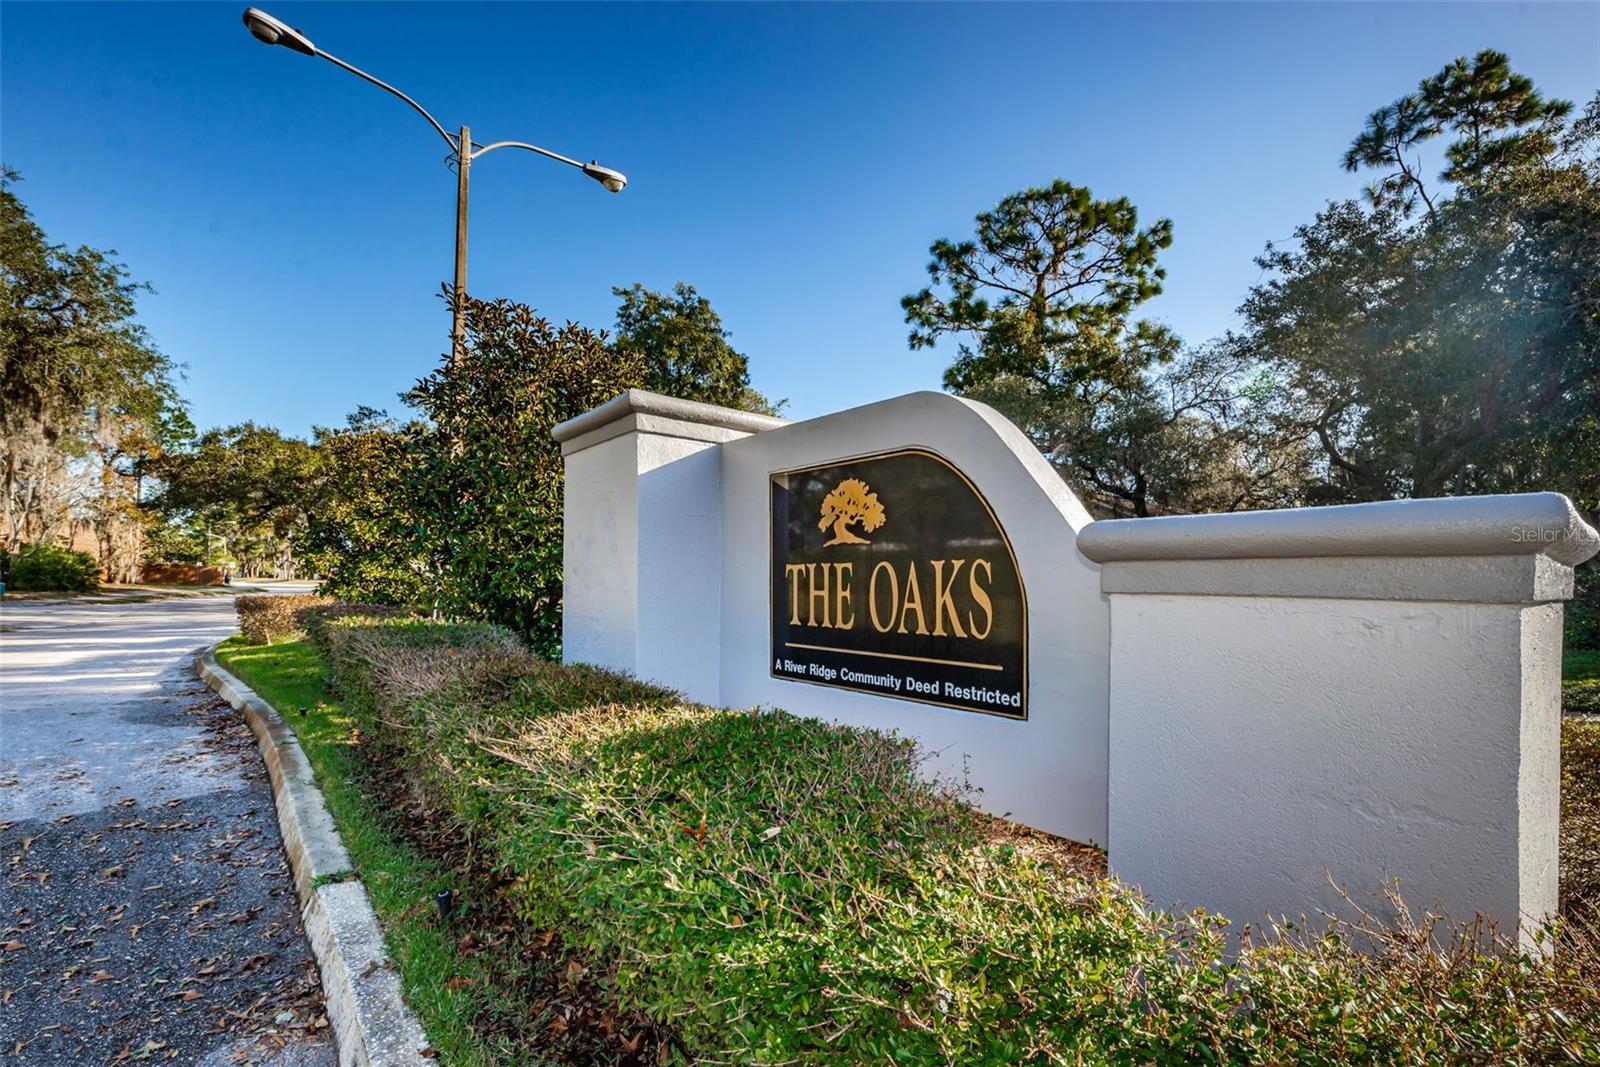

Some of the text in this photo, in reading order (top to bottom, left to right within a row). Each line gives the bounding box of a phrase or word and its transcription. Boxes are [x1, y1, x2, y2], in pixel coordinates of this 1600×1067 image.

[785, 558, 993, 640] THE OAKS
[775, 659, 1020, 707] A River Ridge Community Deed Restricted
